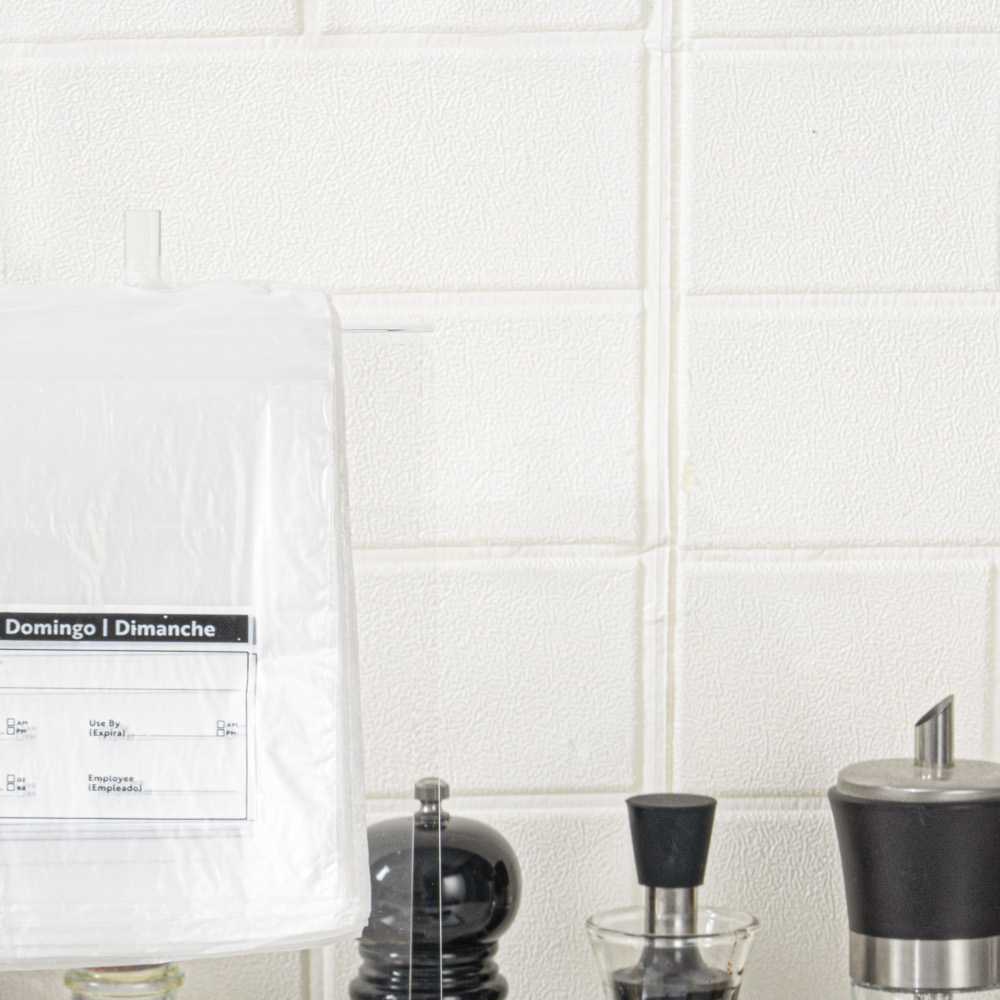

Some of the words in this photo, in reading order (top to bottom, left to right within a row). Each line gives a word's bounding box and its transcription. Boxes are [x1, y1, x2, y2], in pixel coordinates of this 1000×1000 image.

[5, 618, 97, 639] Domingo
[115, 619, 216, 638] Dimanche
[89, 719, 106, 728] Use
[108, 719, 121, 729] By
[89, 729, 126, 738] (Expira)
[88, 774, 135, 784] Employee
[88, 783, 143, 793] (Empleado)
